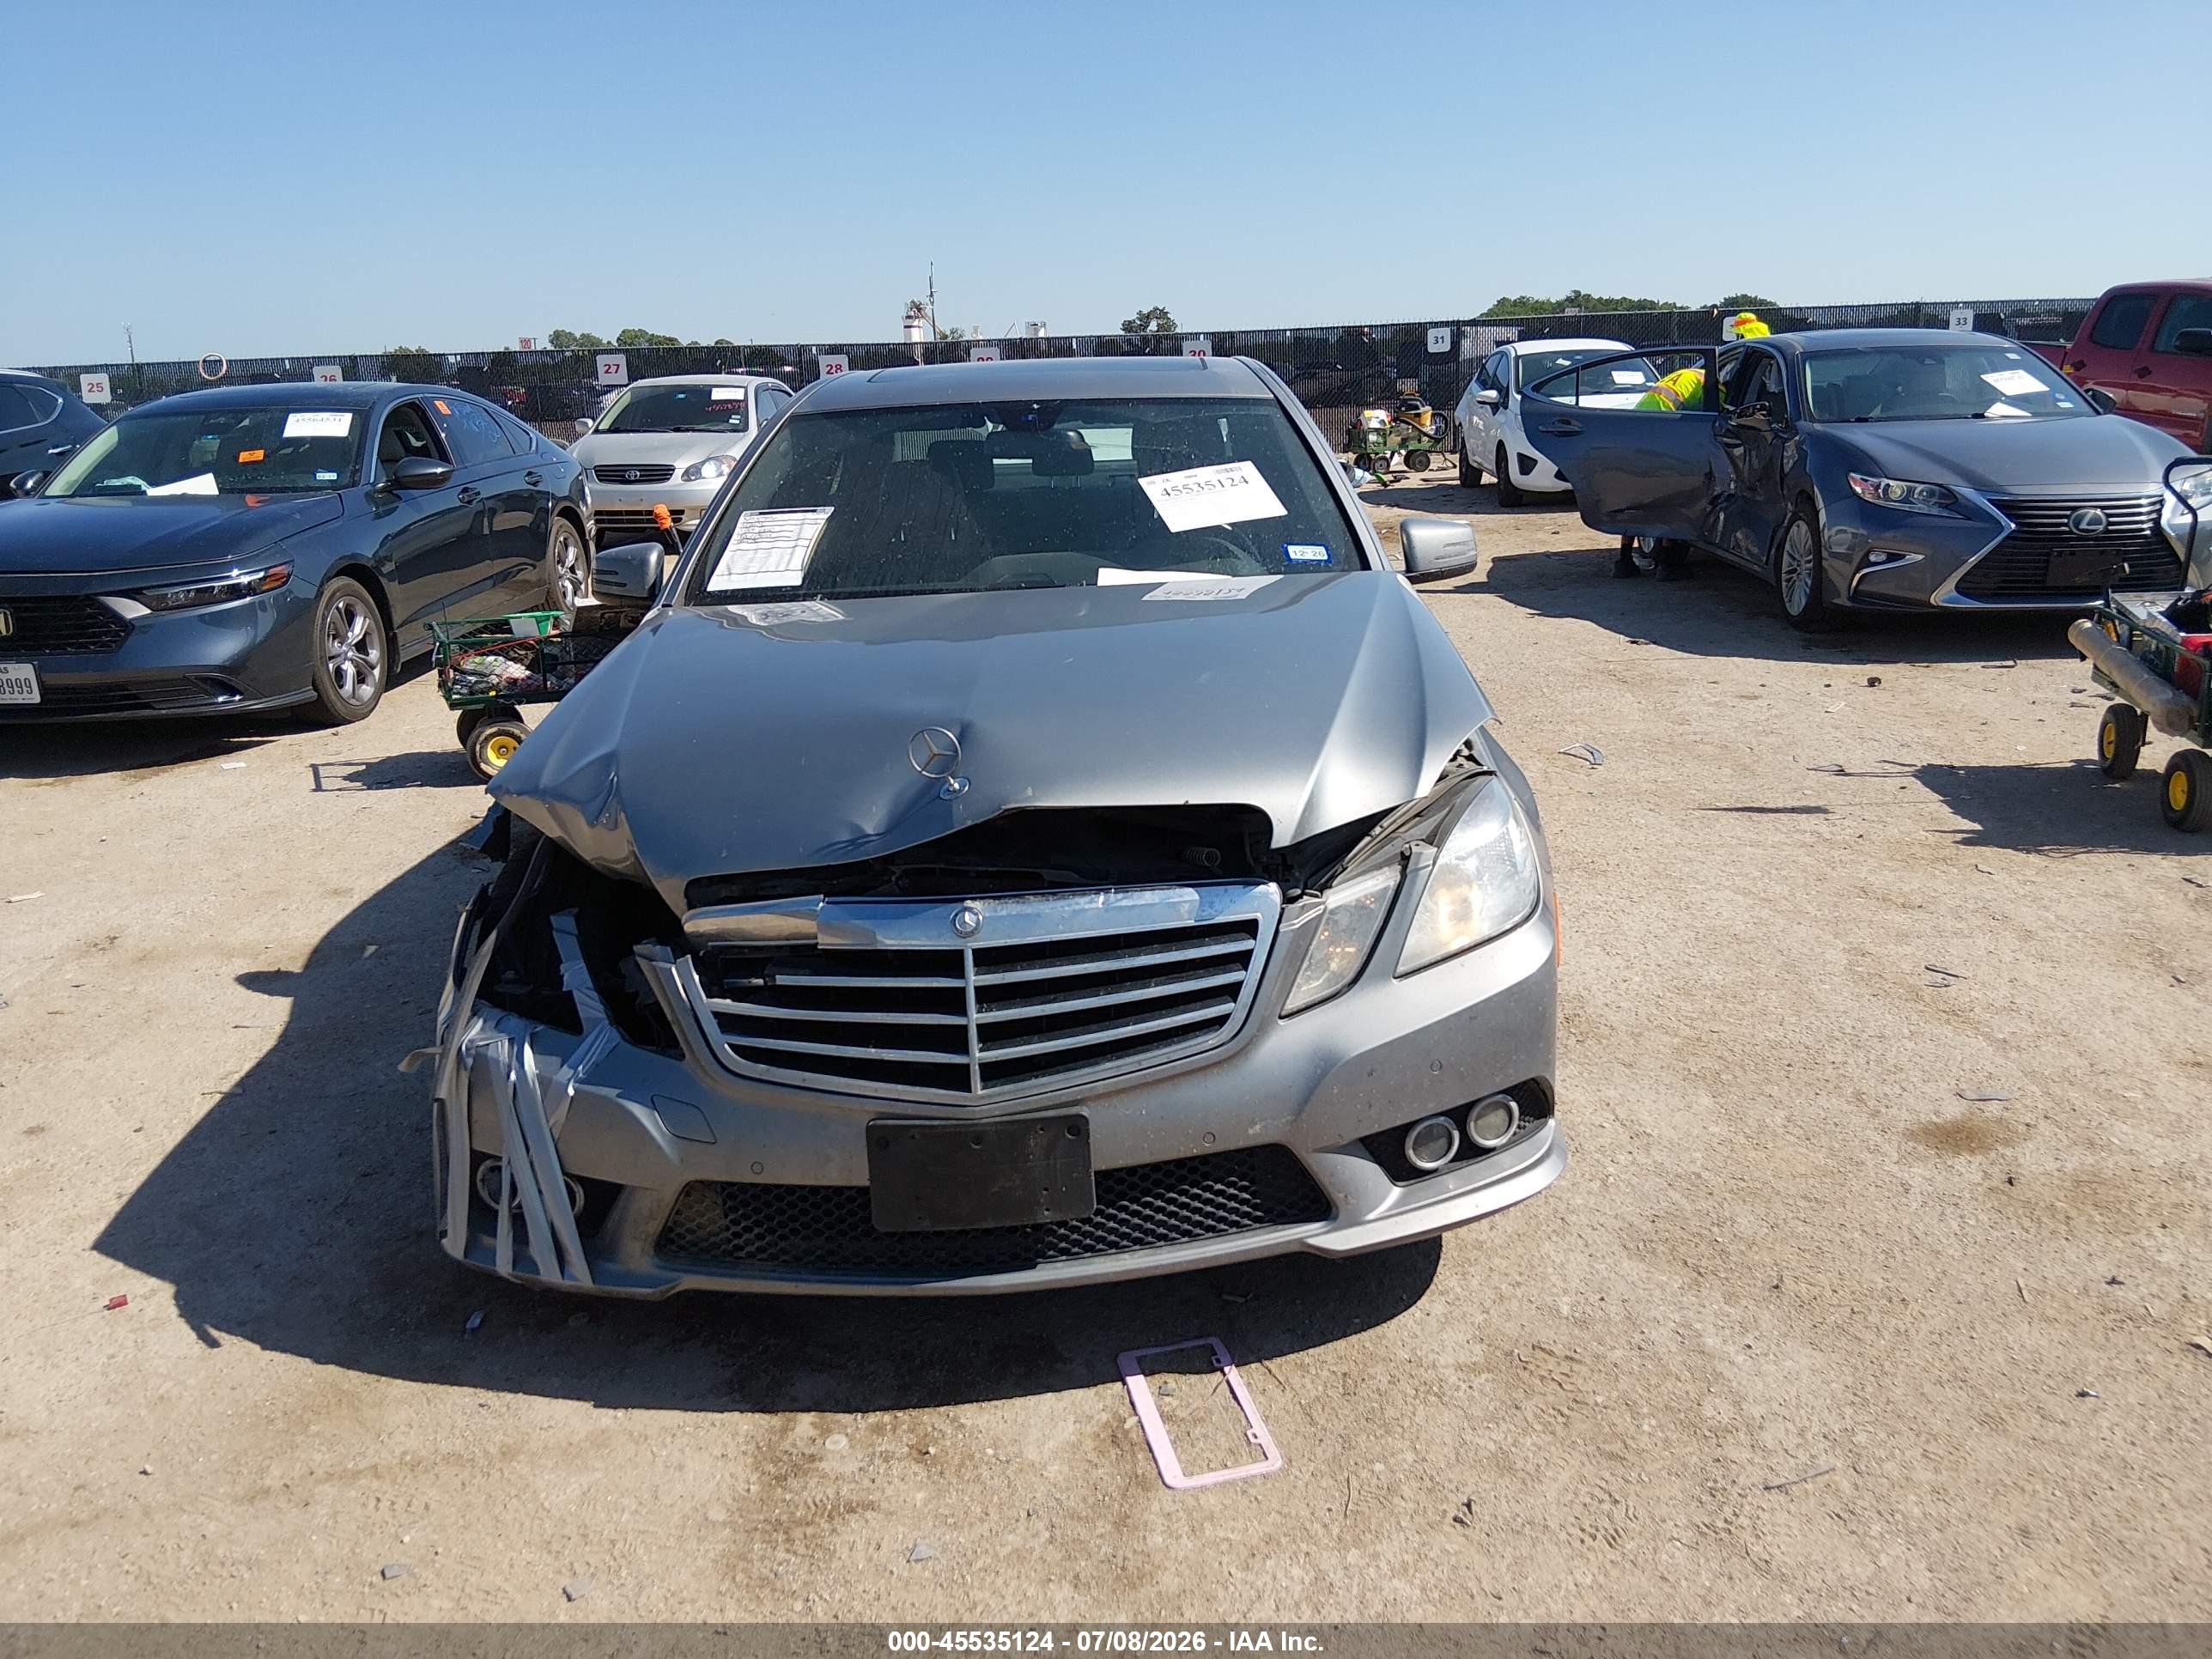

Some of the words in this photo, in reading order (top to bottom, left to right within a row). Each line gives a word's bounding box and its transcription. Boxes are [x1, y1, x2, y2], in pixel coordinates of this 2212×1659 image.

[1955, 317, 1968, 326] 33
[1433, 336, 1444, 344] 31
[604, 363, 620, 374] 27
[825, 363, 843, 374] 28
[87, 382, 104, 393] 25
[1160, 475, 1249, 497] 45535124
